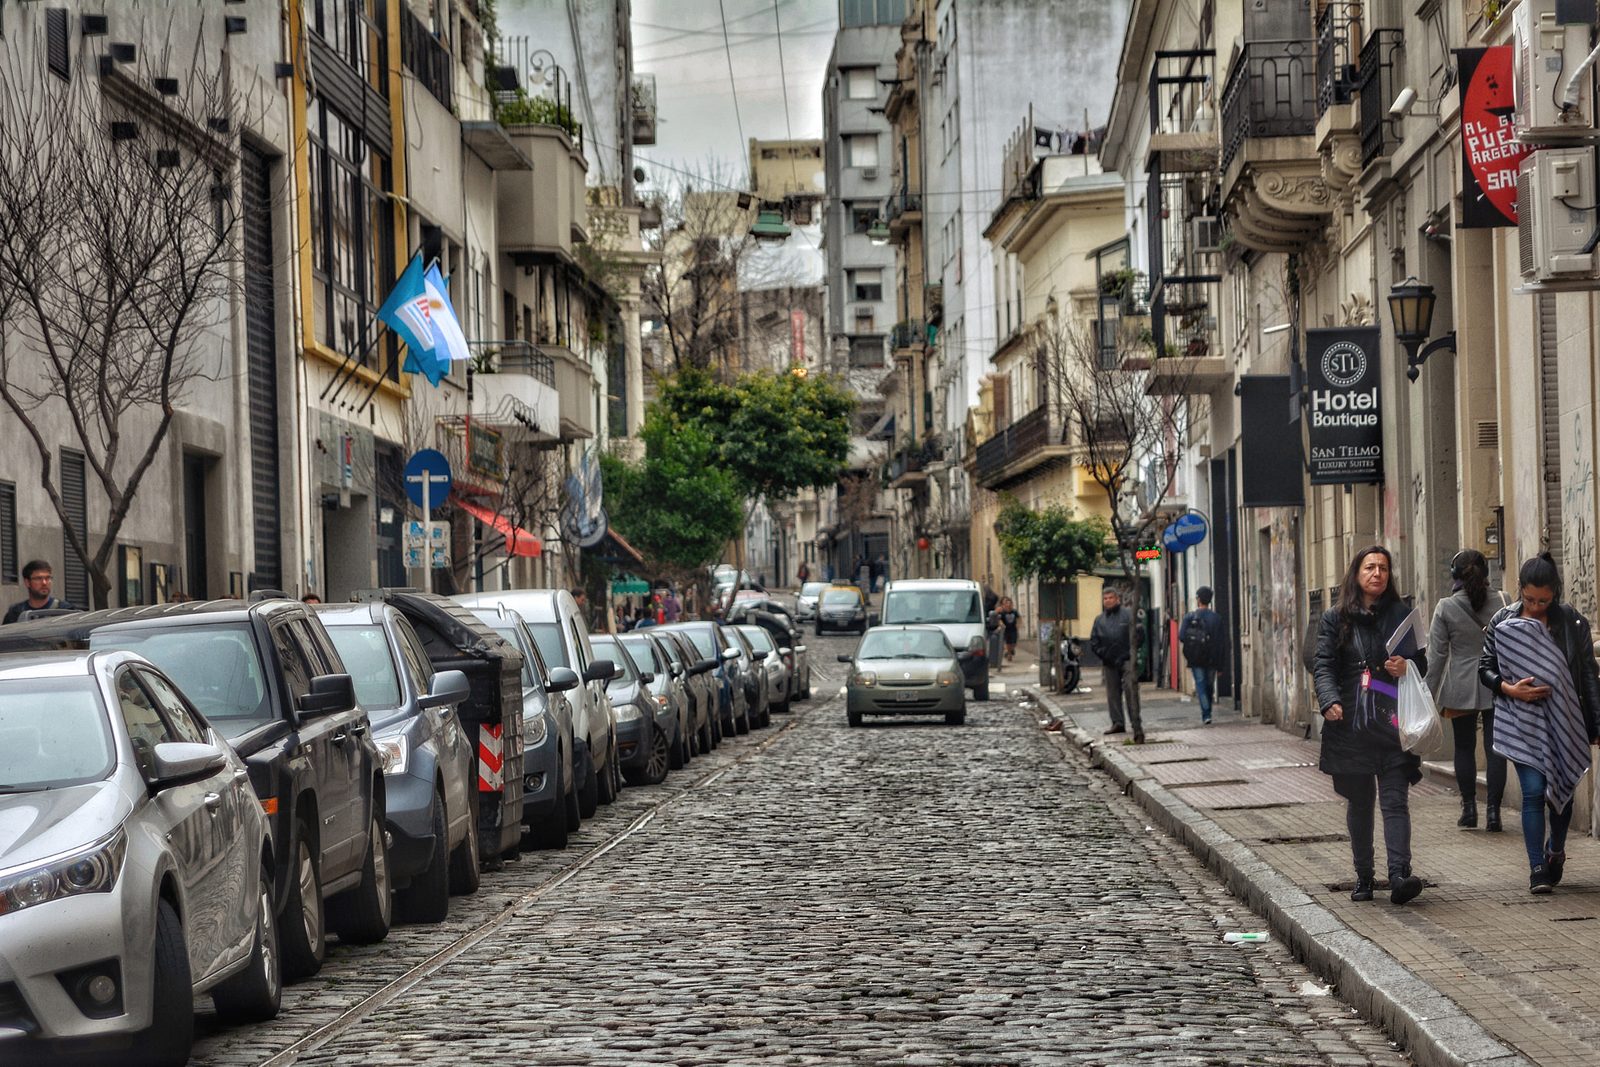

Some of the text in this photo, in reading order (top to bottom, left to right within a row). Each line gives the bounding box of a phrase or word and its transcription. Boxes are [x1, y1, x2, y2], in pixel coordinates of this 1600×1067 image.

[1465, 121, 1487, 136] AL
[1330, 353, 1358, 373] STL
[1312, 386, 1377, 411] Hotel
[1313, 411, 1378, 427] Boutique
[1312, 445, 1380, 458] SAN TELMO
[1318, 460, 1375, 470] LUXURY SUITES
